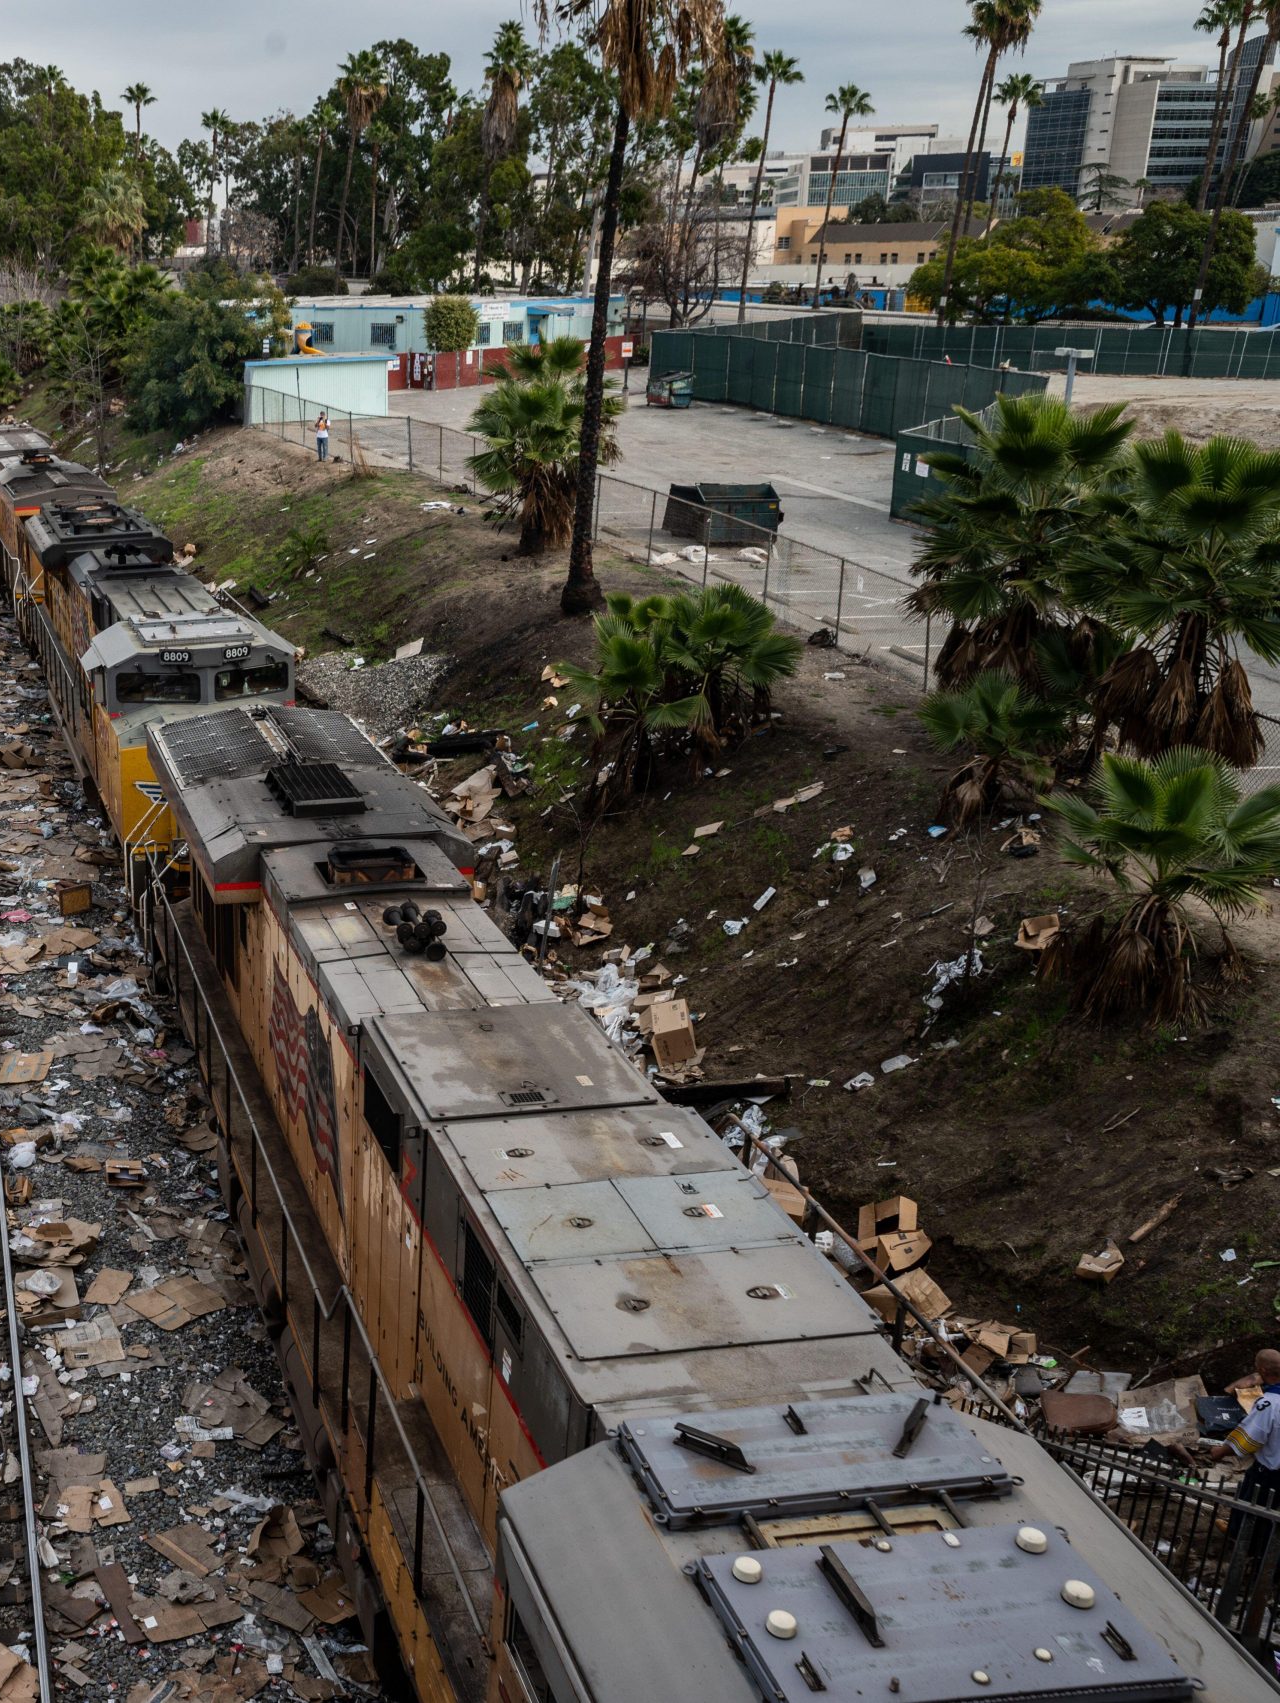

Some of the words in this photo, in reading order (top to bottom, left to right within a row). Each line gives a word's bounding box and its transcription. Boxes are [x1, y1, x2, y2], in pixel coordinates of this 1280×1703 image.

[163, 651, 189, 662] 8809
[225, 646, 249, 659] 8809
[418, 1309, 458, 1407] BUILDING
